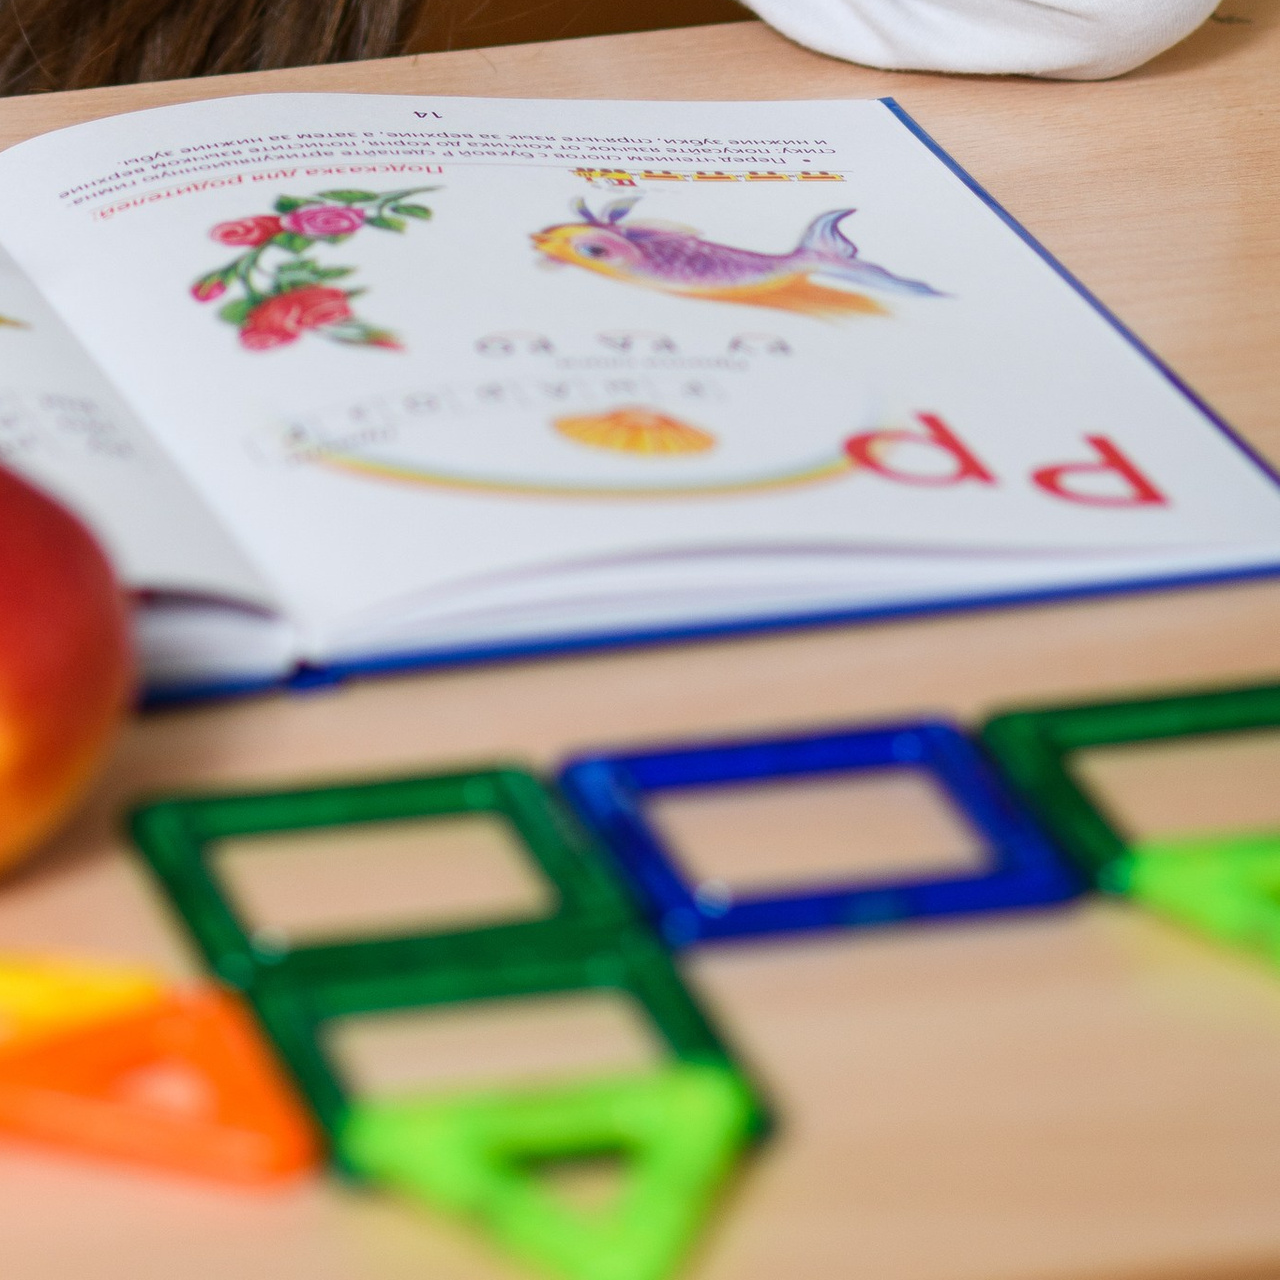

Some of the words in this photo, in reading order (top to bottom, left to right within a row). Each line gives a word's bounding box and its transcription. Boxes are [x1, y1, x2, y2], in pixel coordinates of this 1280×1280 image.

[412, 111, 443, 119] 14
[268, 134, 291, 142] за
[296, 131, 358, 140] затем
[506, 134, 555, 142] язык
[561, 136, 653, 144] спрячьте
[179, 137, 263, 154] нижние
[248, 140, 357, 154] почистите
[436, 140, 461, 148] до
[466, 141, 553, 150] кончика
[341, 149, 436, 158] сделайте
[585, 145, 661, 154] язычок
[665, 147, 771, 156] покусайте
[458, 150, 534, 160] буквой
[553, 152, 622, 162] слогов
[626, 155, 716, 164] чтением
[151, 150, 243, 170] язычком
[718, 156, 786, 165] Перед
[142, 150, 334, 183] артикуляционную
[305, 163, 444, 177] Подсказка
[251, 168, 297, 181] для
[59, 167, 145, 199] верхние
